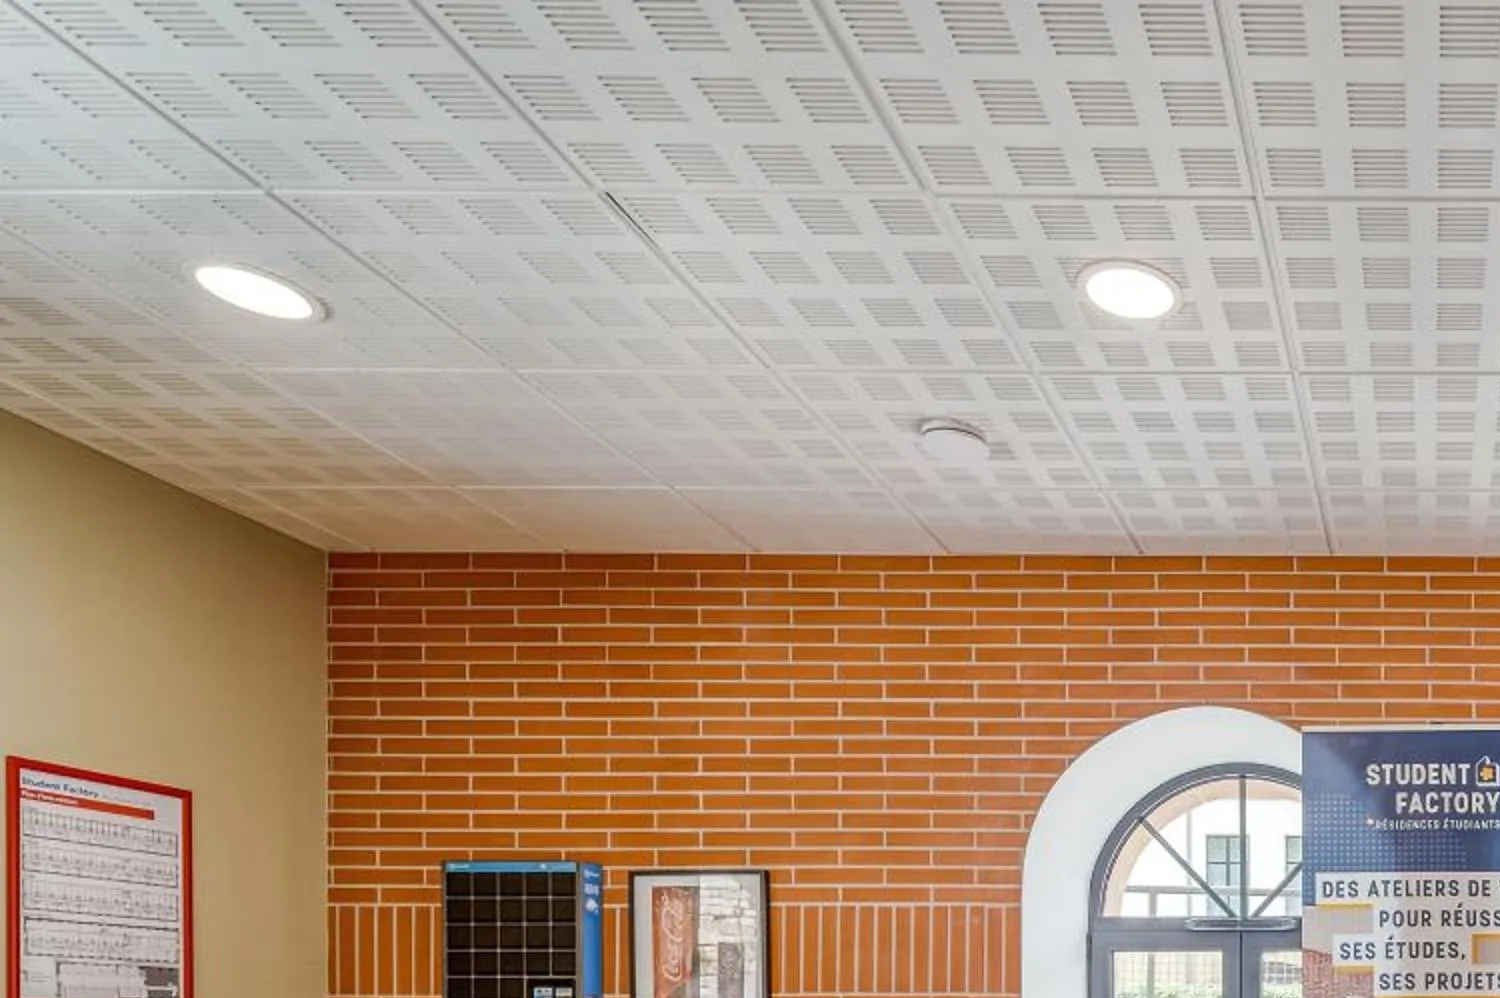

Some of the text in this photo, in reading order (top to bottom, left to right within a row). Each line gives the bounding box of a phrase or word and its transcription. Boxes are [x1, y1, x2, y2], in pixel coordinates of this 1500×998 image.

[1365, 762, 1471, 786] STUDENT
[1395, 791, 1500, 814] FACTORY
[1322, 879, 1359, 898] DES
[1367, 879, 1460, 898] ATELIERS
[1468, 879, 1491, 897] DE
[1379, 910, 1432, 928] POUR
[1339, 936, 1466, 961] SES ÉTUDES,
[1379, 972, 1416, 991] SES
